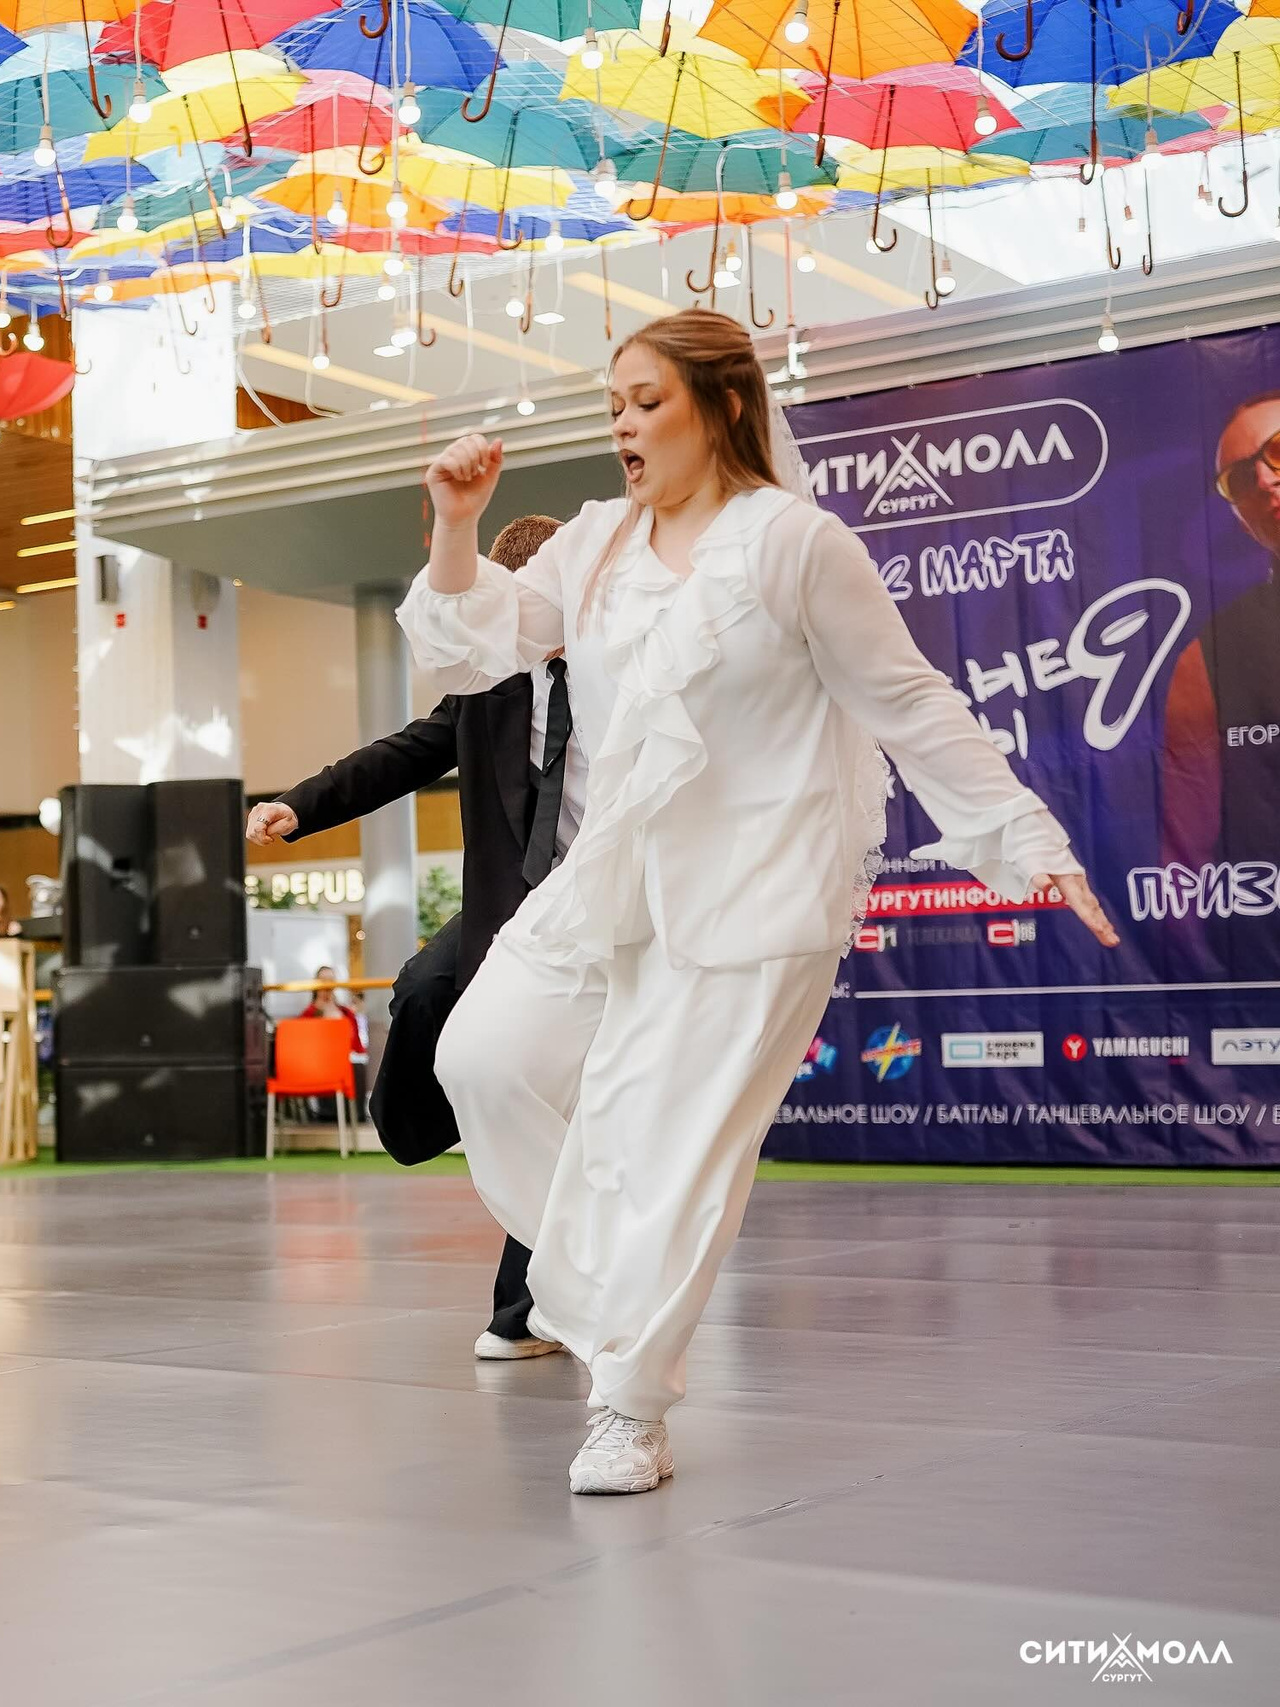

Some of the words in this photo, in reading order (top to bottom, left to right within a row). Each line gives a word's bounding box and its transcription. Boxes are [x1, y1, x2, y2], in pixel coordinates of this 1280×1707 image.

[802, 450, 887, 496] ИТИ
[925, 423, 1075, 477] МОЛЛ
[877, 493, 939, 515] СУРГУТ
[920, 528, 1075, 597] МАРТА
[1126, 861, 1280, 922] ПРИЗ
[1092, 1036, 1190, 1057] YAMAGUCHI
[871, 1104, 920, 1124] ШОУ
[936, 1104, 1009, 1125] БАТТЛЫ
[1028, 1104, 1189, 1126] ТАНЦЕВАЛЬНОЕ
[1193, 1104, 1251, 1125] ШОУ
